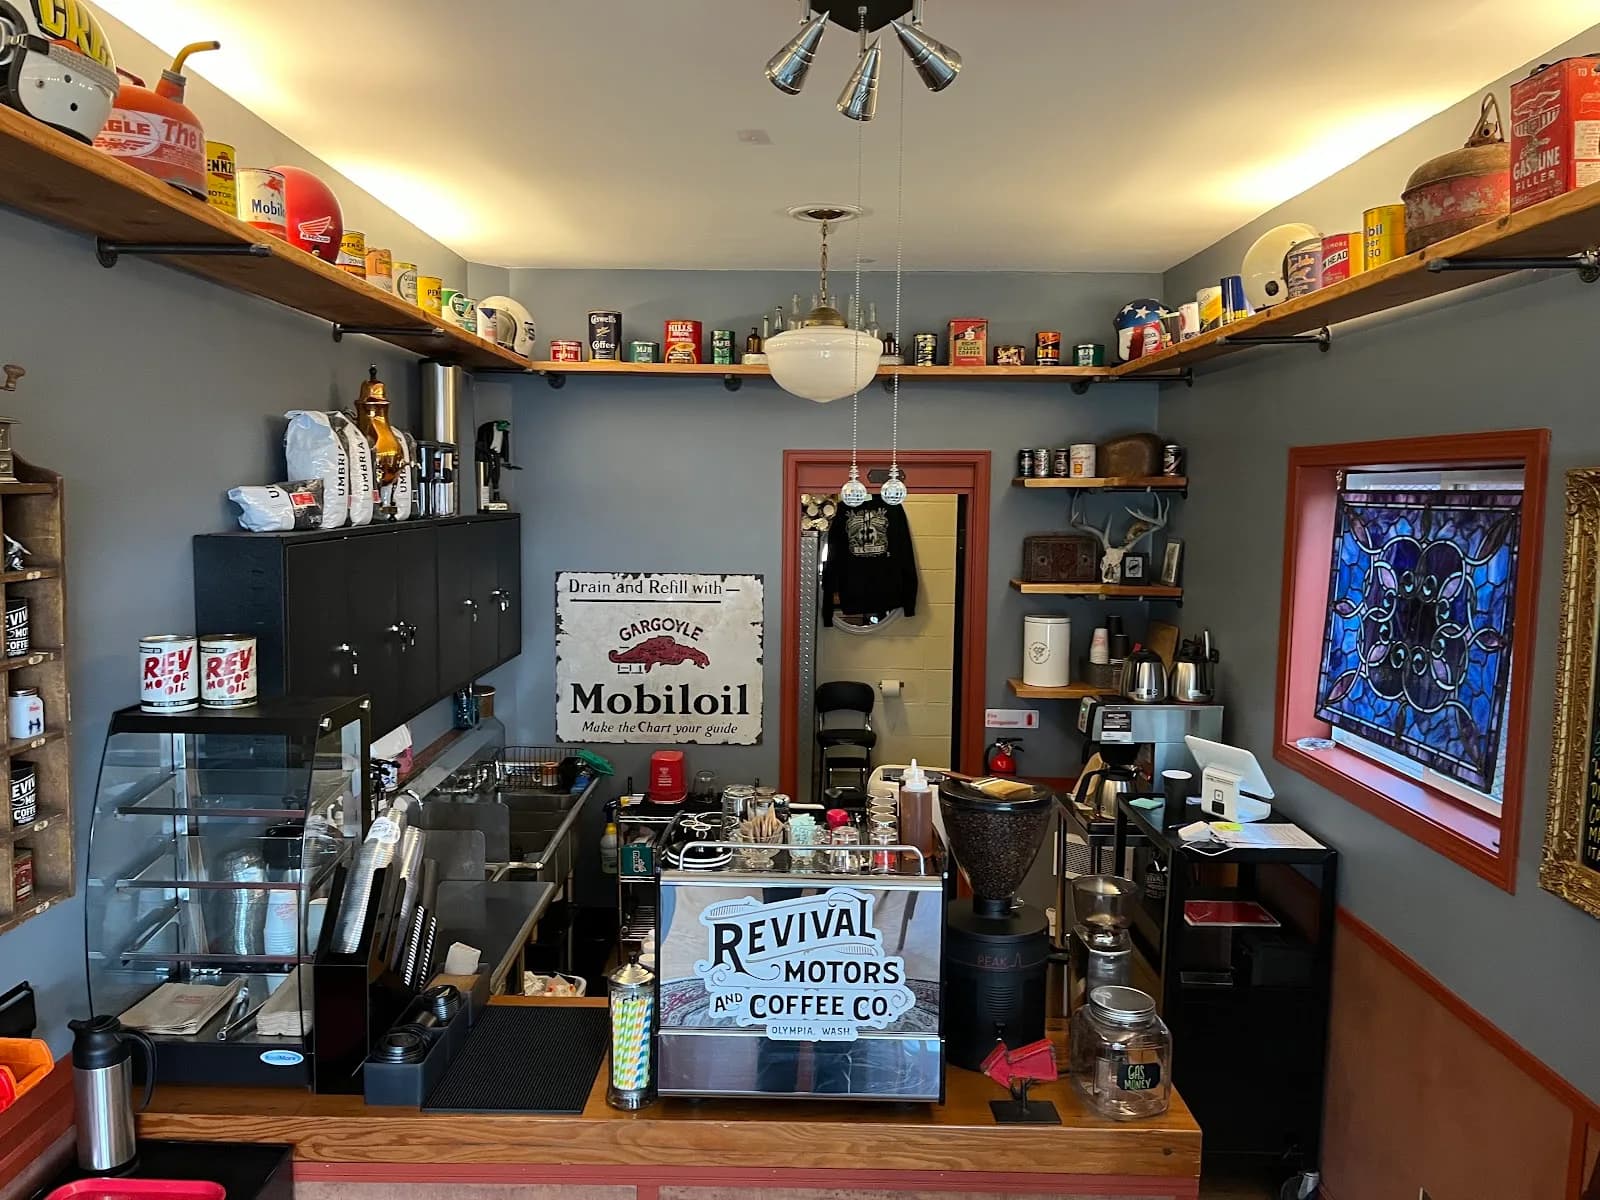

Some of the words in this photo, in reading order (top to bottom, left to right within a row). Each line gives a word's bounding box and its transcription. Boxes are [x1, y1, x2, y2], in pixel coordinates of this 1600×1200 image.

[103, 119, 151, 137] GLE
[162, 118, 197, 150] The
[1513, 146, 1560, 180] GASLINE
[1515, 169, 1556, 193] FILLER
[668, 324, 693, 332] HILLS
[357, 441, 370, 492] UMBRIA
[569, 579, 611, 594] Drain
[615, 579, 643, 594] and
[649, 579, 688, 595] Refill
[619, 617, 704, 642] GARGOYLE
[143, 646, 193, 680] REV
[206, 646, 253, 681] REV
[144, 671, 190, 691] MOTOR
[165, 682, 186, 696] OIL
[207, 671, 250, 690] MOTOR
[227, 683, 247, 696] OIL
[570, 683, 750, 715] Mobiloil
[582, 721, 614, 733] Make
[618, 721, 636, 733] the
[637, 721, 671, 734] Chart
[673, 723, 702, 736] your
[706, 721, 738, 738] guide
[711, 896, 877, 974] REVIVAL
[784, 960, 899, 985] MOTORS
[714, 992, 743, 1013] AND
[749, 994, 844, 1019] COFFEE
[853, 996, 893, 1021] CO.
[1124, 1078, 1152, 1090] MONEY
[1127, 1064, 1146, 1080] GAS
